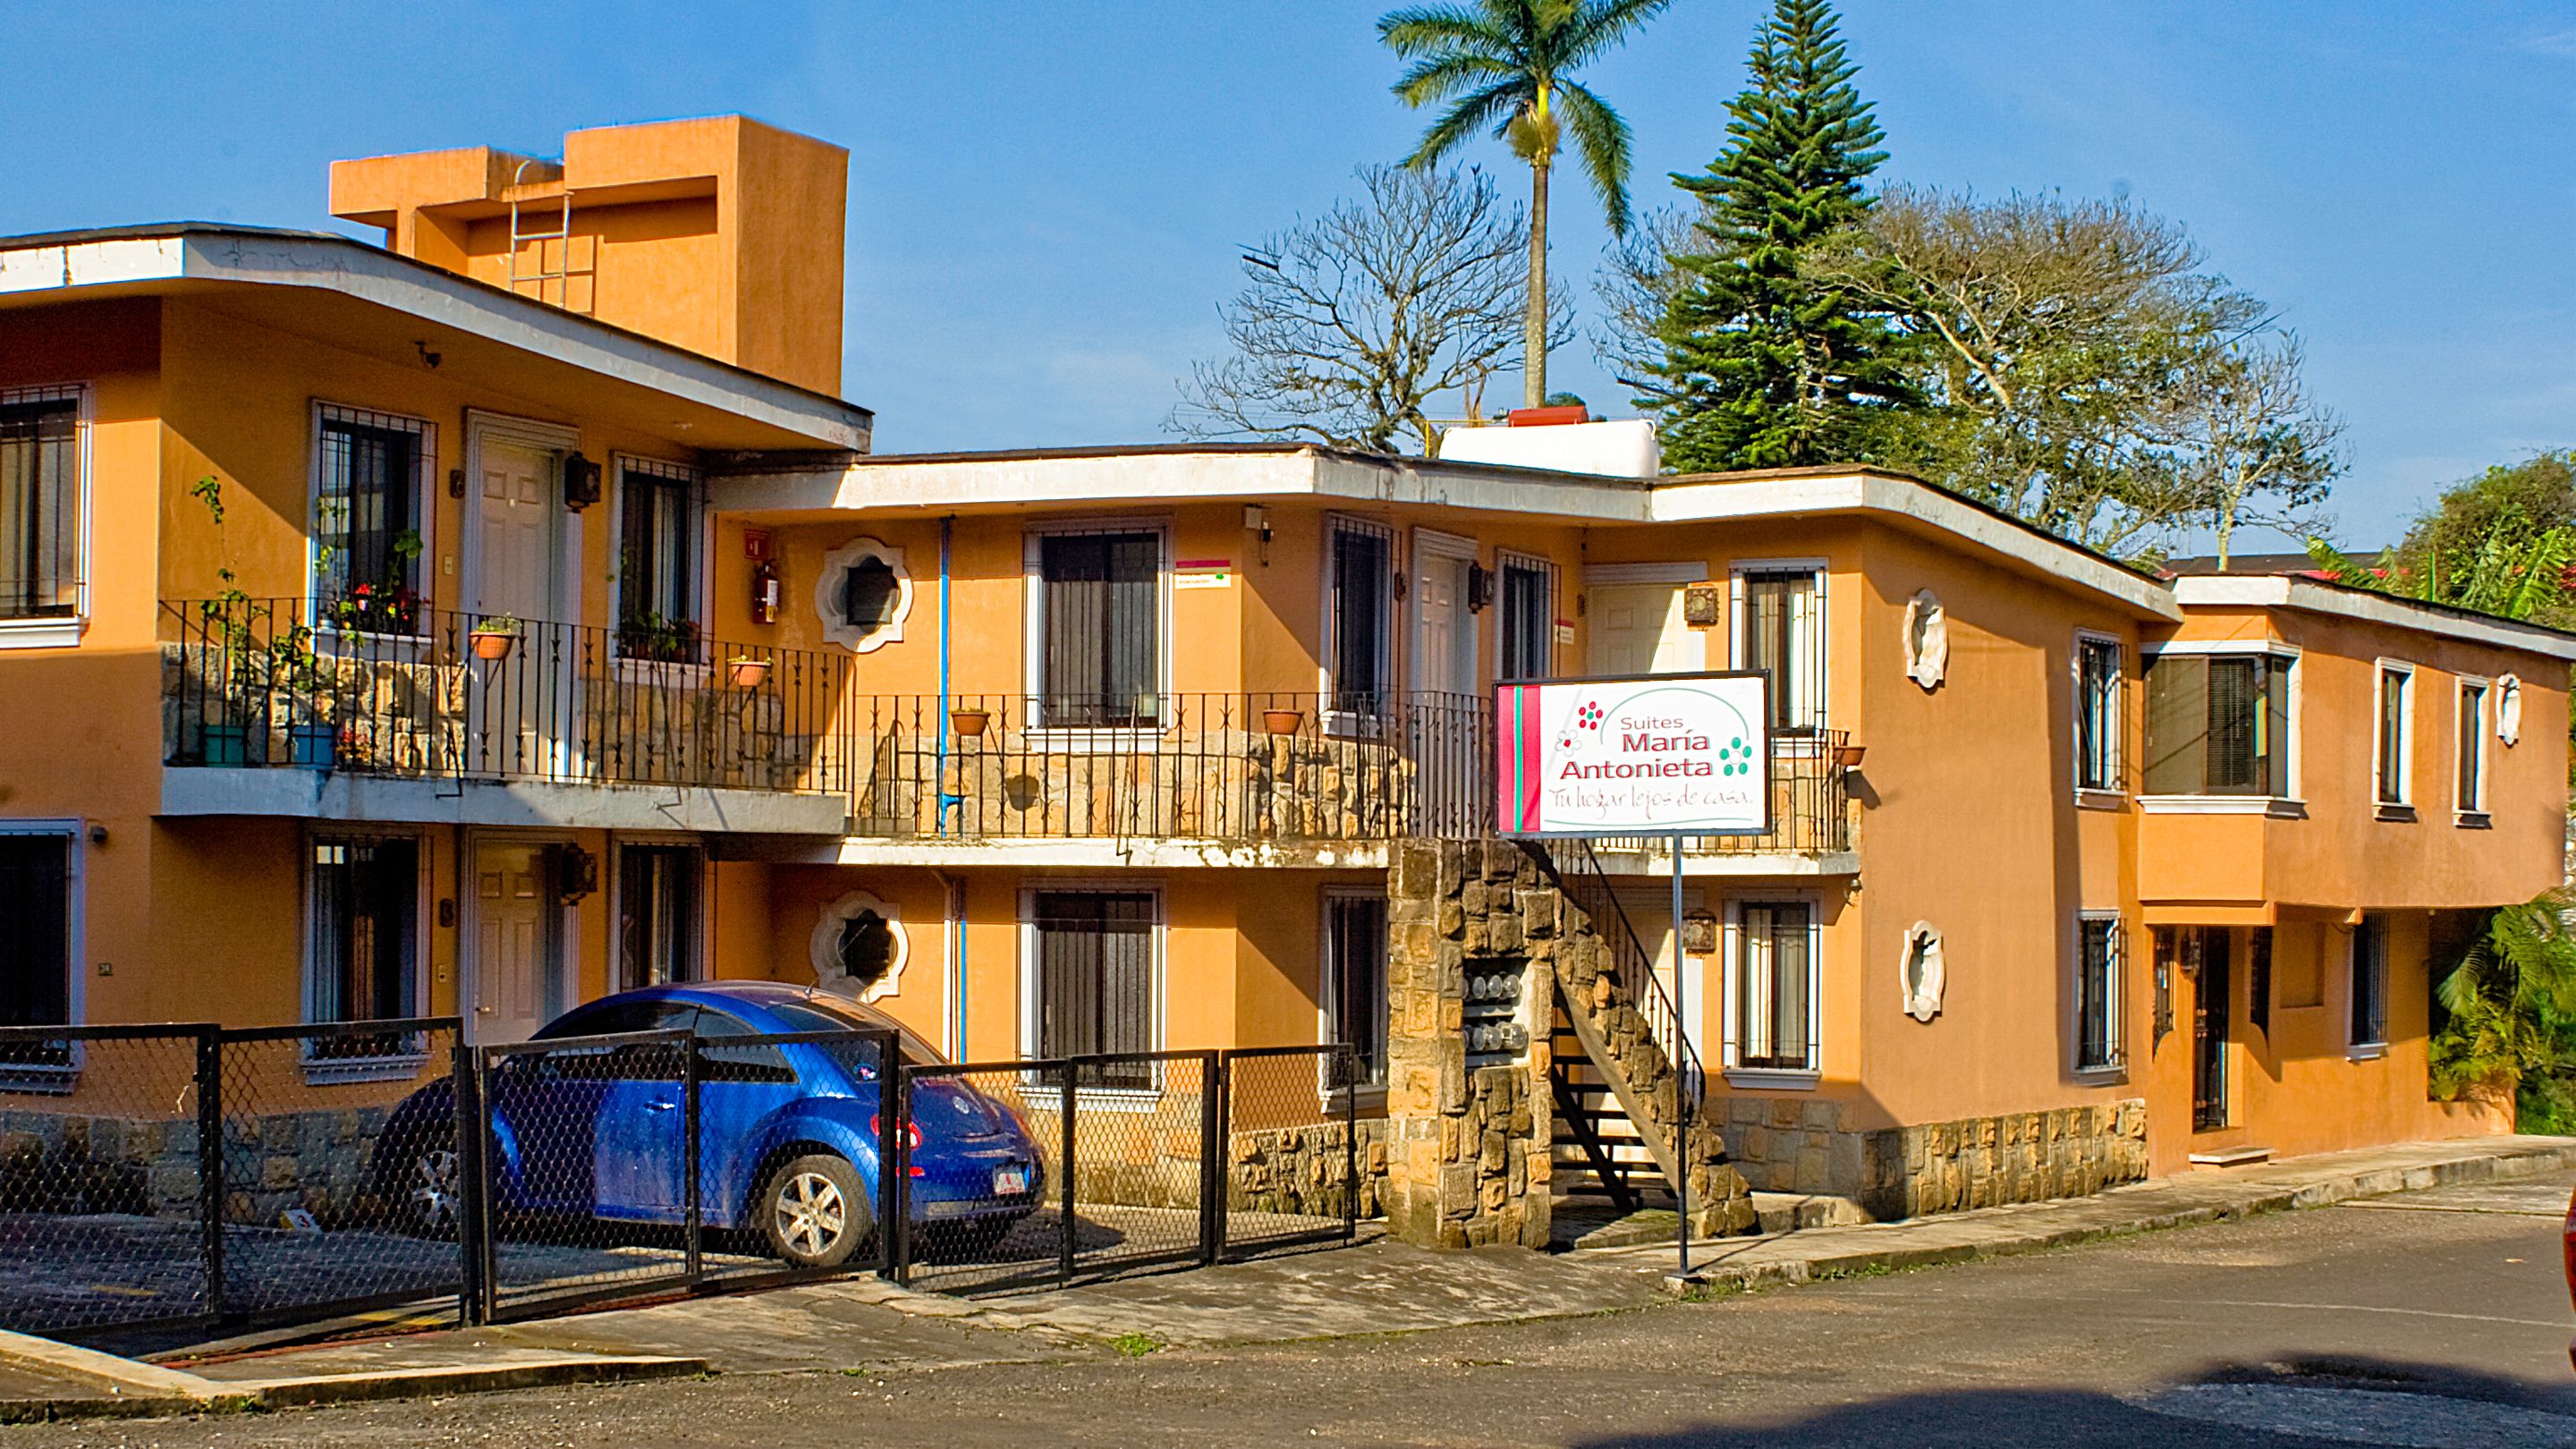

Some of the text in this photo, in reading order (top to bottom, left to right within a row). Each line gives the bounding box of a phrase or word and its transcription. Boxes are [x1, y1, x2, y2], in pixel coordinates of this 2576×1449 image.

[1620, 716, 1683, 730] Suites
[1622, 729, 1710, 752] María
[1559, 758, 1714, 780] Antonieta
[1547, 787, 1572, 808] Tu
[1576, 784, 1627, 820] hogar
[1631, 784, 1671, 820] lejos
[1676, 784, 1698, 807] de
